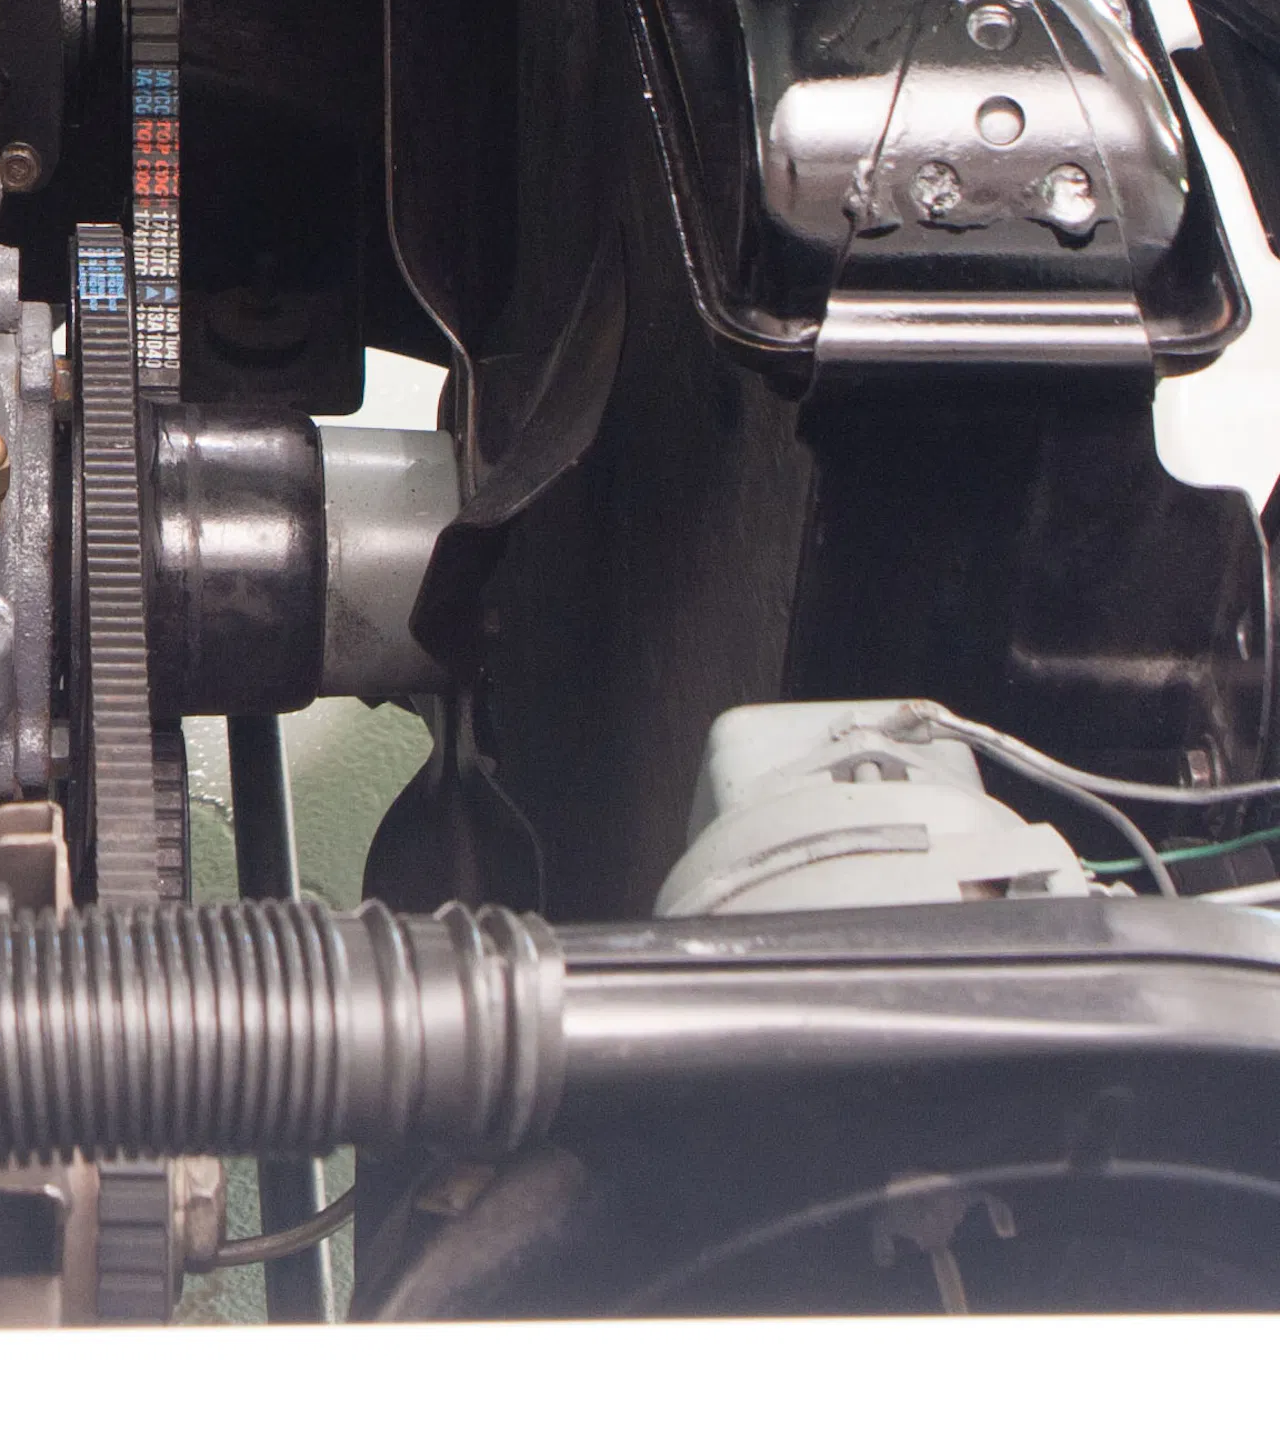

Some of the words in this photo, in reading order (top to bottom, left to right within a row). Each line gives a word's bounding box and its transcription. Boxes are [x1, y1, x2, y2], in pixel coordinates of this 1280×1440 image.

[136, 120, 152, 155] TOP
[155, 120, 171, 155] TOP
[149, 210, 169, 277] 17410TC
